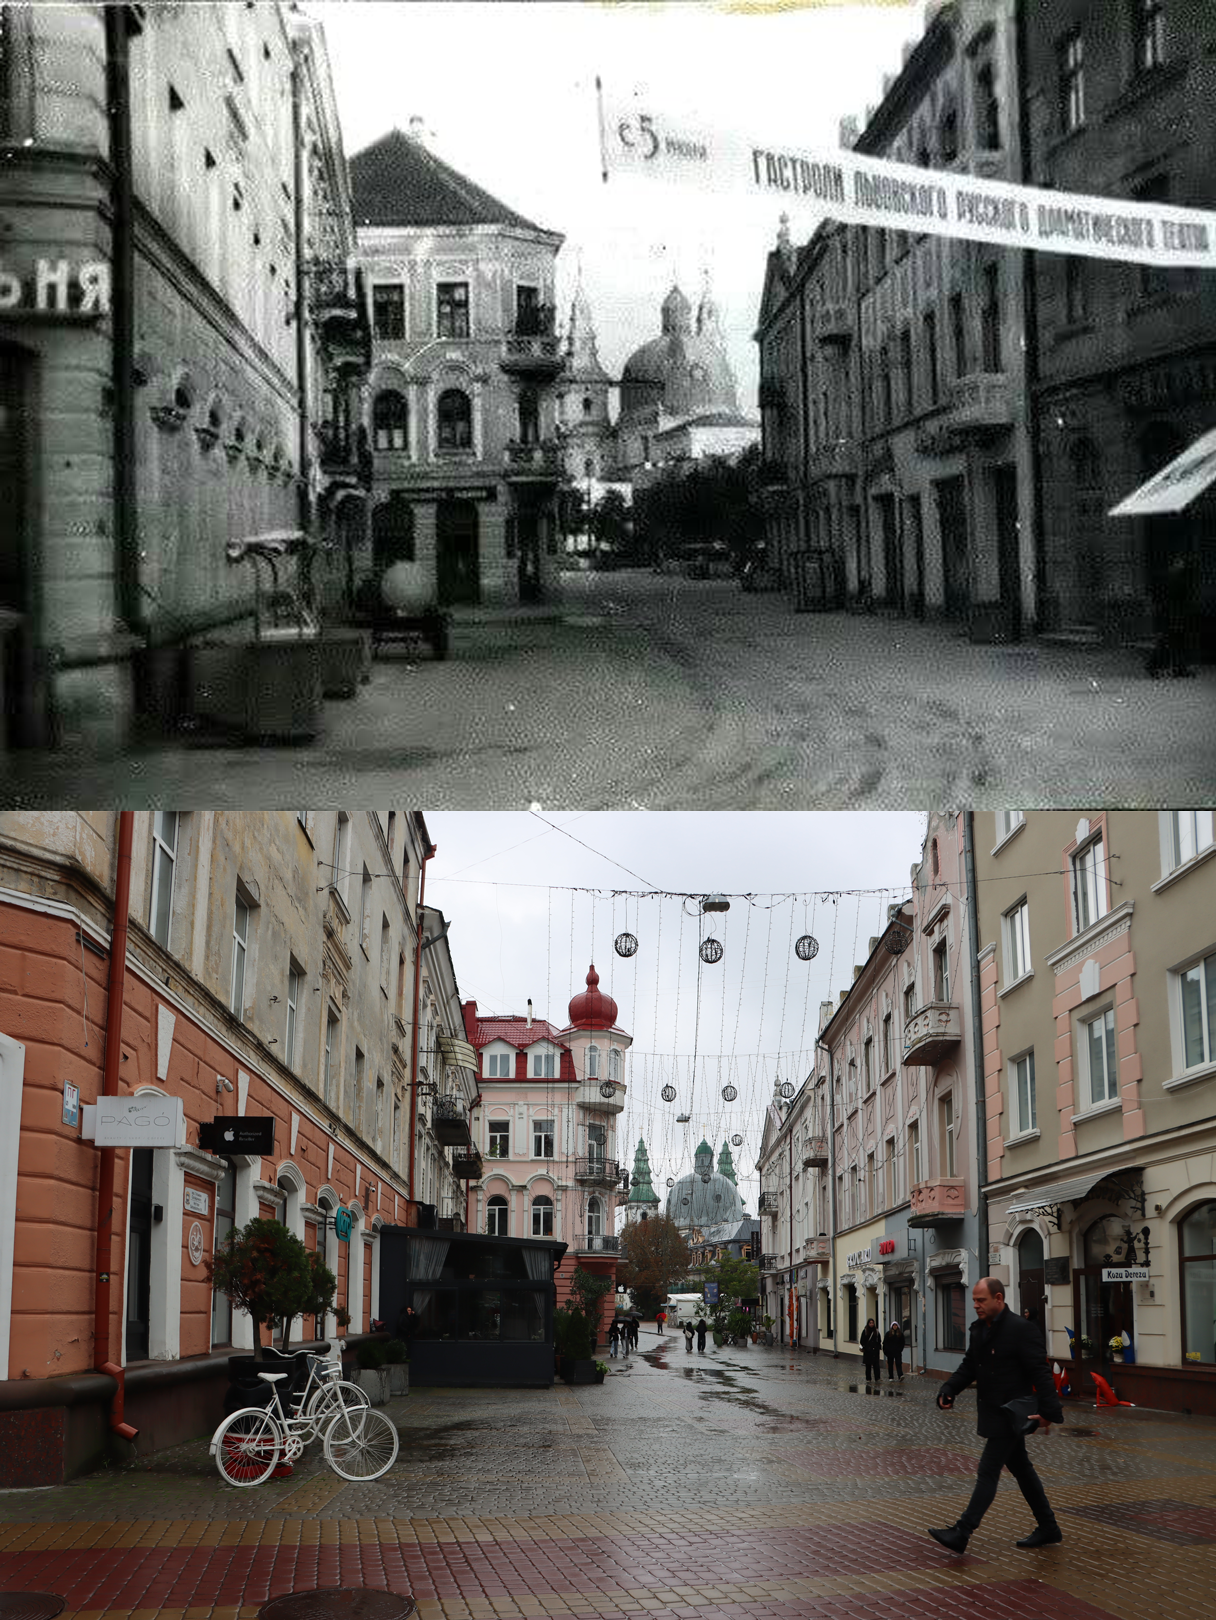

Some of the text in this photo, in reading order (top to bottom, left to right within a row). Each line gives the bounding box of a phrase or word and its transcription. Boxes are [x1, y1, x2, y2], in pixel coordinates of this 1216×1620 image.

[638, 114, 660, 160] 5
[752, 148, 846, 206] ГАСТРОЛИ
[101, 1112, 171, 1127] PAGÓ
[1107, 1269, 1147, 1279] Koza Dereza
